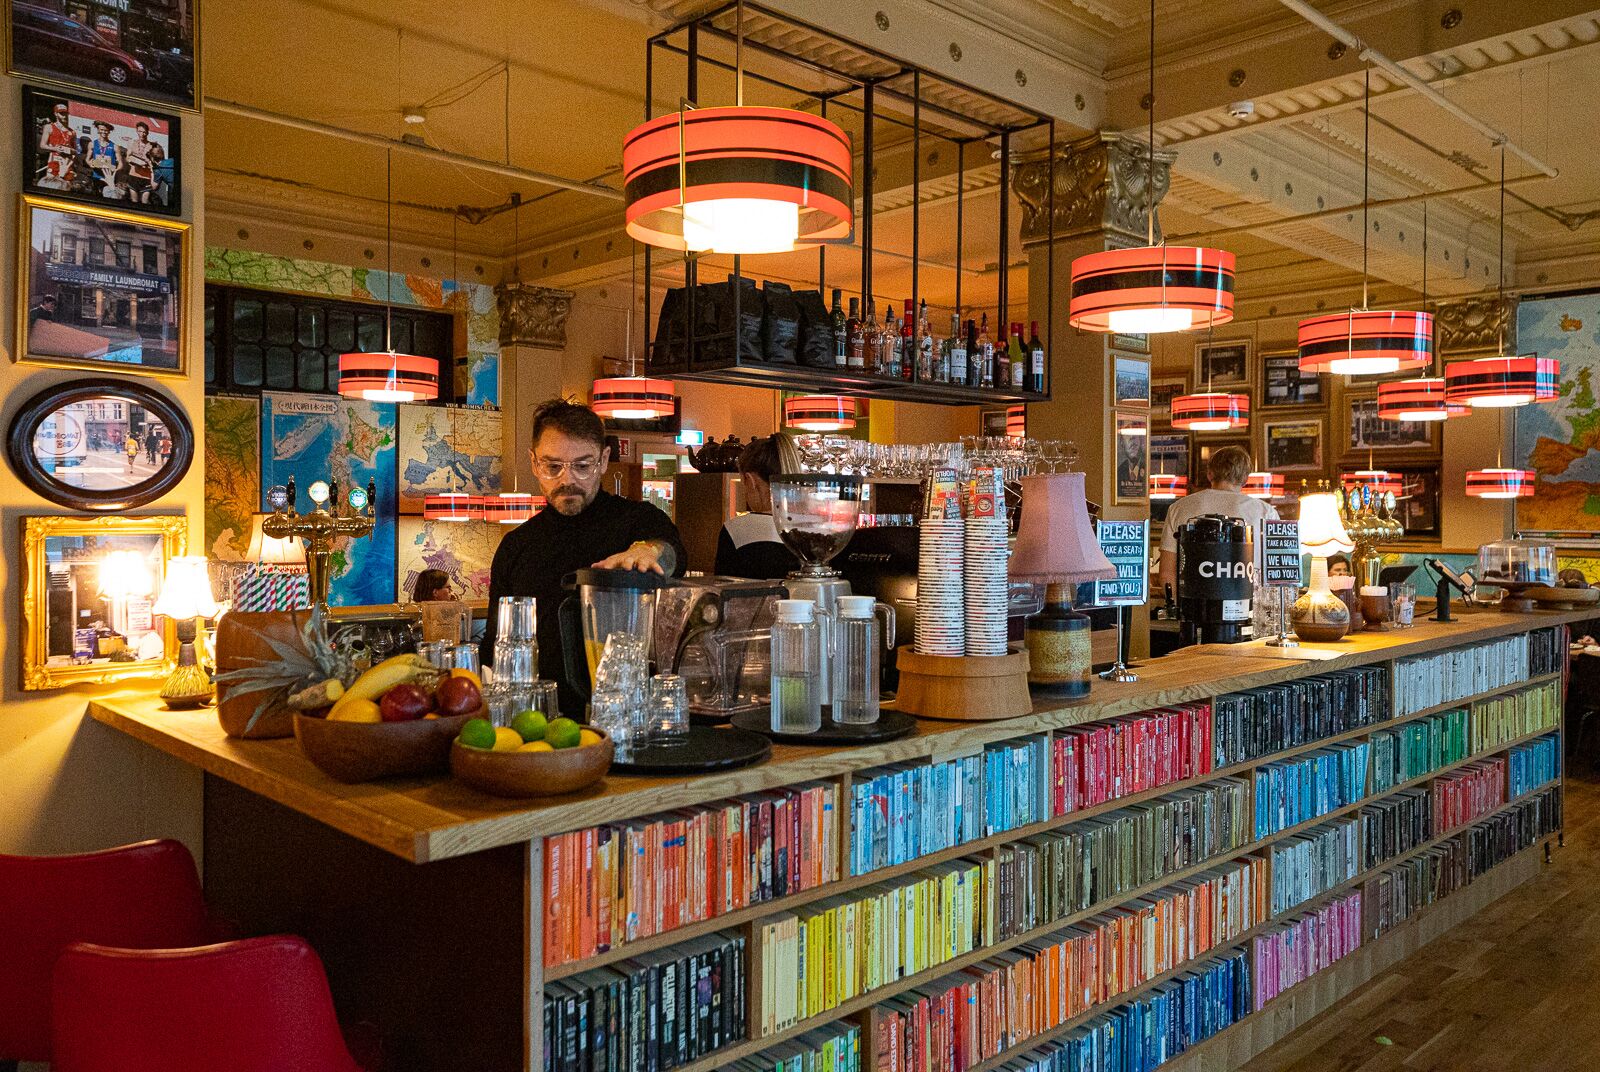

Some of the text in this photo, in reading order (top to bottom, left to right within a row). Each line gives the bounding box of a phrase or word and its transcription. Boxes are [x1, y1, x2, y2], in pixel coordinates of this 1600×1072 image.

[90, 272, 113, 283] FAMILY
[115, 276, 159, 289] LAUNDROMAT
[1102, 525, 1142, 540] PLEASE
[1267, 523, 1297, 536] PLEASE
[1267, 539, 1279, 547] TAKE
[1102, 545, 1116, 555] TAKE
[1118, 546, 1123, 554] A
[1267, 555, 1299, 566] WE WILL
[1119, 565, 1141, 578] WILL
[1198, 561, 1254, 583] CHAQ
[1267, 570, 1281, 578] FIND
[1100, 583, 1117, 595] FIND
[665, 963, 676, 1022] WELLINGTON
